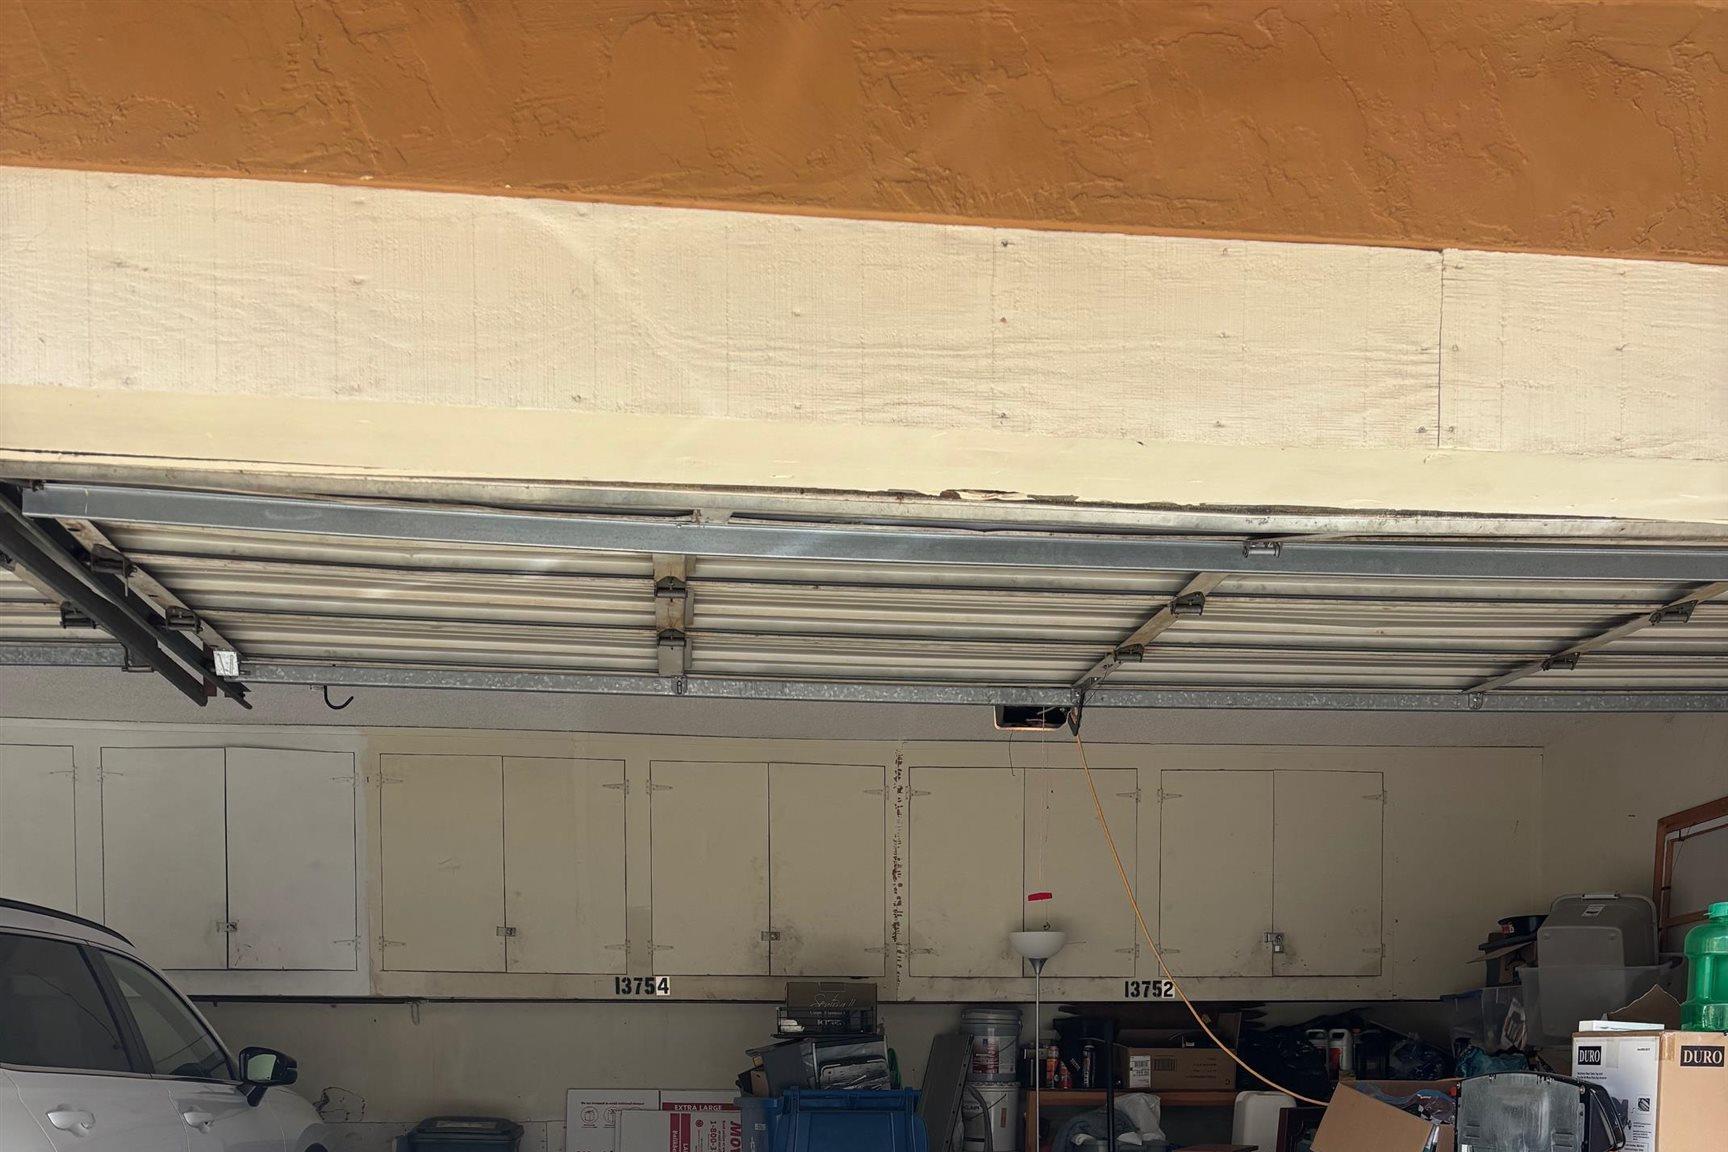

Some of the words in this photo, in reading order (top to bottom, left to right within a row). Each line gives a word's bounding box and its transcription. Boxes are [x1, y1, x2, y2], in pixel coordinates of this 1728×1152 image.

[615, 977, 670, 995] 13754
[1124, 980, 1175, 998] 13752
[1579, 1049, 1600, 1063] DURO
[1682, 1049, 1723, 1064] DURO
